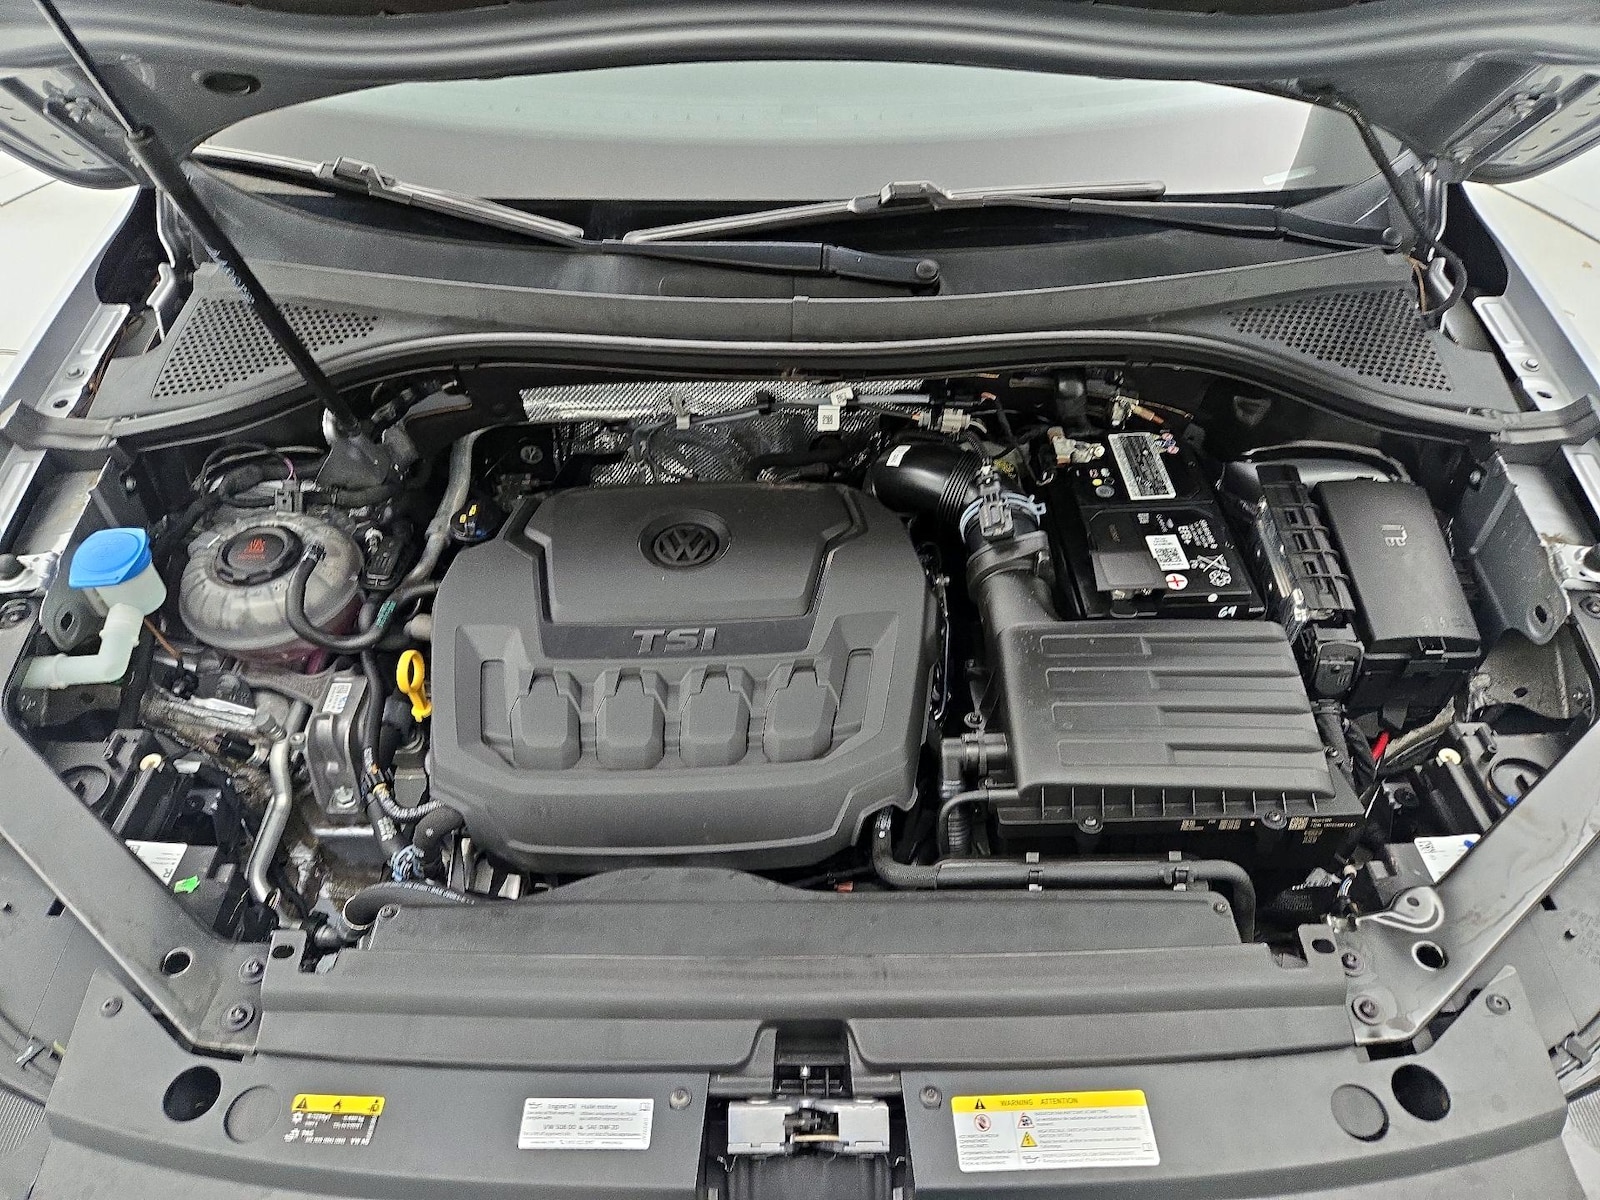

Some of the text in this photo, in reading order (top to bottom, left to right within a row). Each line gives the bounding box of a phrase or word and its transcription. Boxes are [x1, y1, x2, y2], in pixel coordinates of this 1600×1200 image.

[632, 627, 718, 655] TSI
[1000, 1096, 1079, 1107] WARNING ATTENTION
